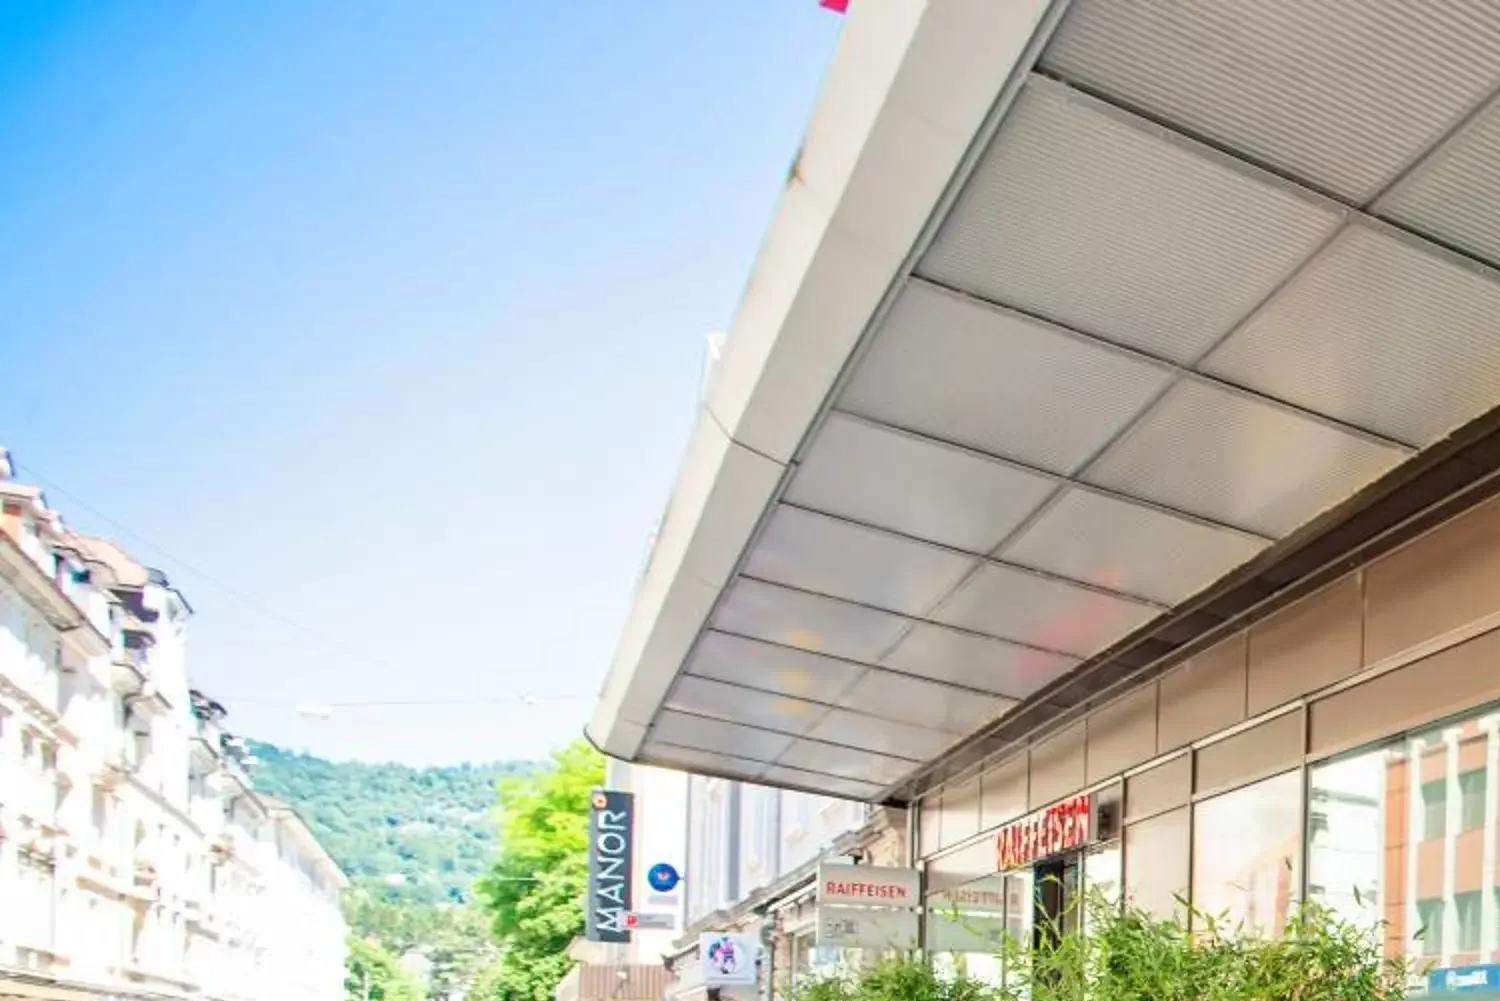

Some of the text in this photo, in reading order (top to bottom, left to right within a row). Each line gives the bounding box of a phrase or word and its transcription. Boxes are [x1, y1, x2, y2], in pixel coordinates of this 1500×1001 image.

[596, 809, 628, 933] MANOR
[996, 794, 1090, 872] RAIFFEISEN
[826, 881, 909, 897] RAIFFEISEN
